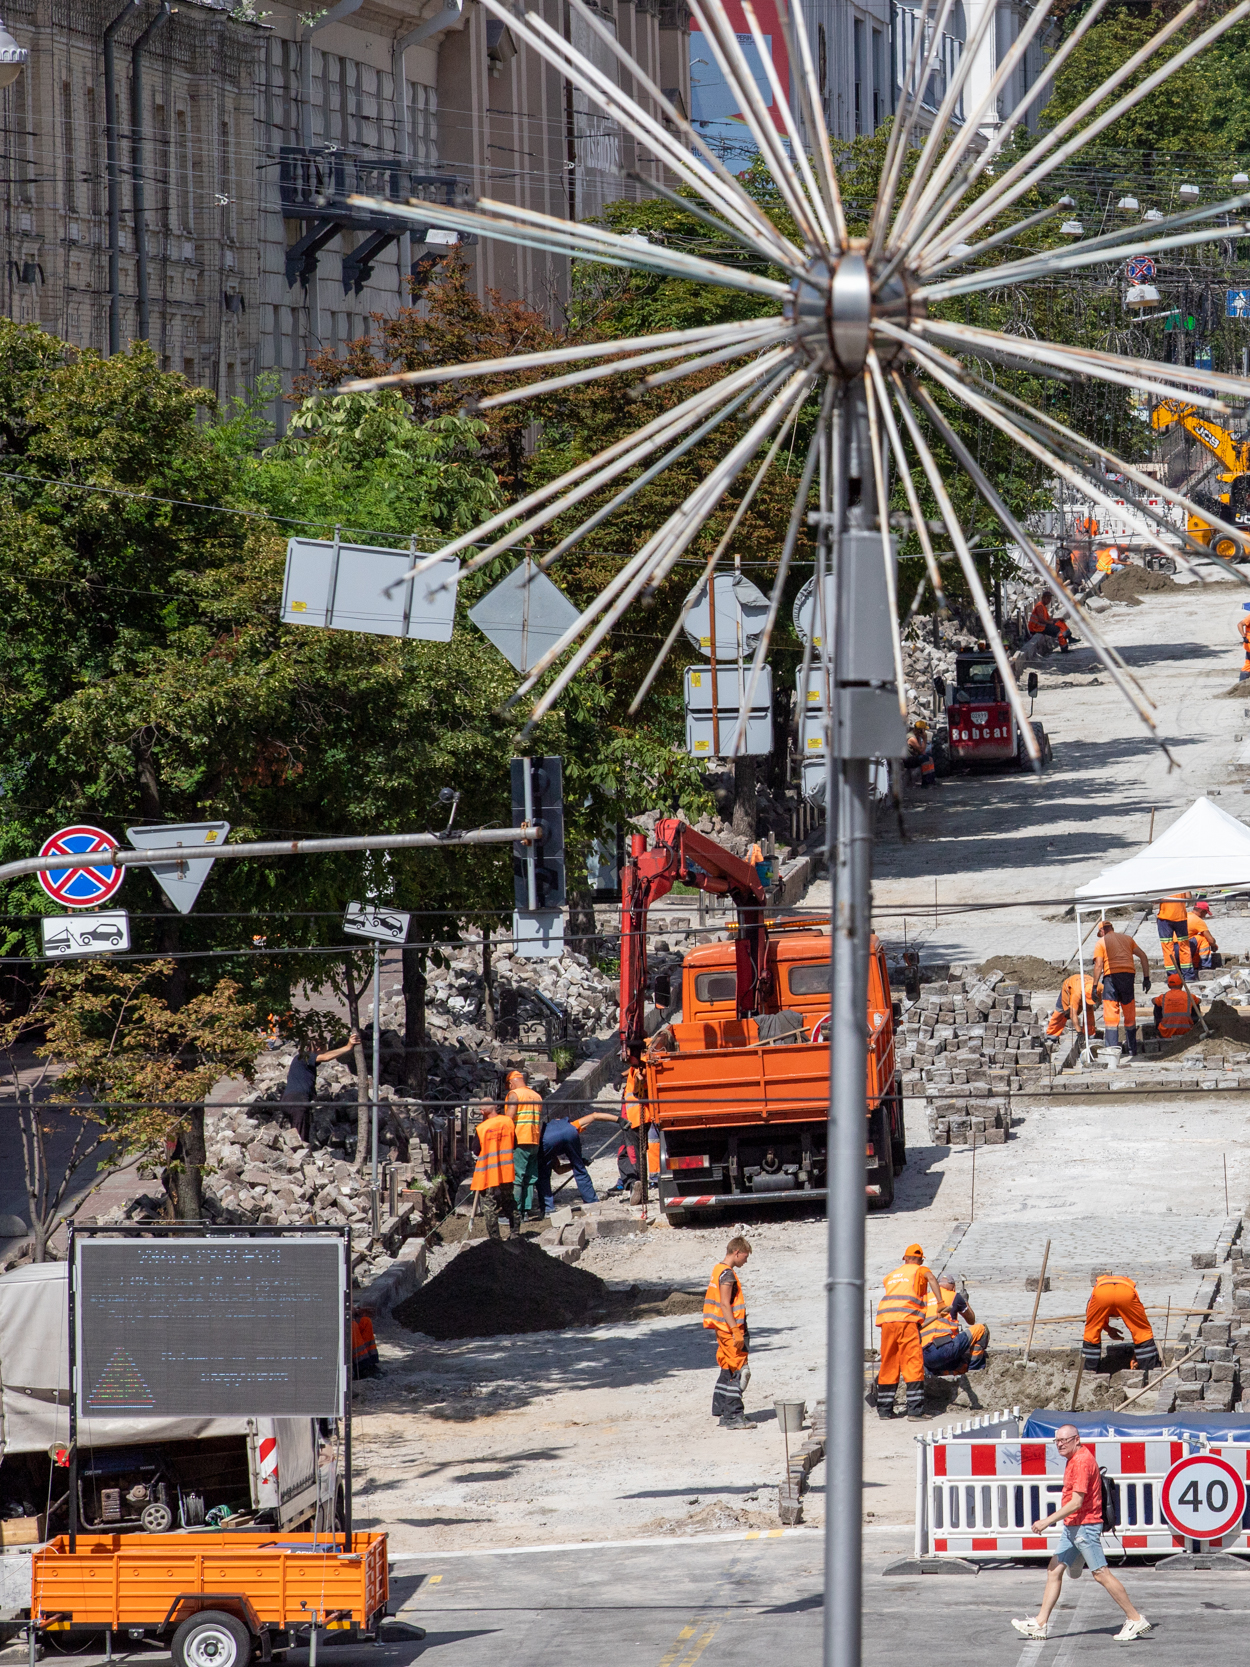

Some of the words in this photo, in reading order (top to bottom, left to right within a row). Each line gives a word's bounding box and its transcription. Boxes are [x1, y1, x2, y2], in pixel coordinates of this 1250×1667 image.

[1195, 426, 1220, 448] JCB
[952, 726, 1008, 741] Bobcat
[1178, 1479, 1229, 1513] 40
